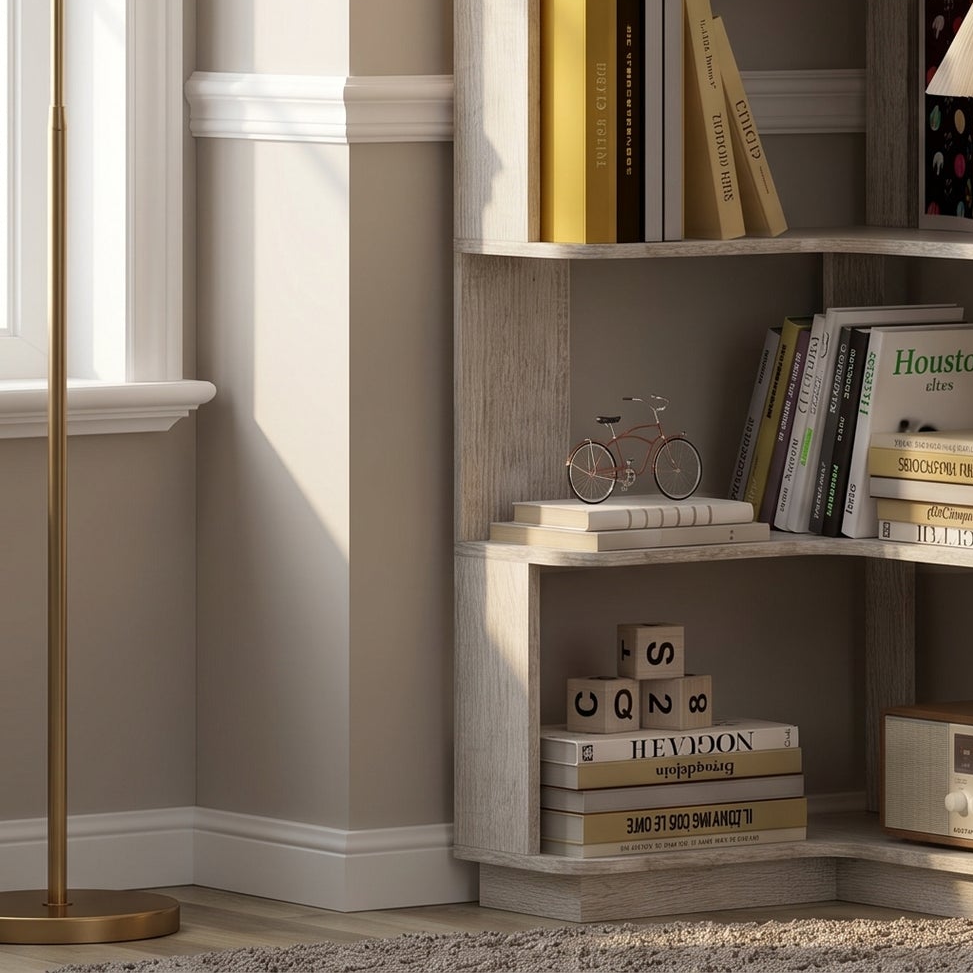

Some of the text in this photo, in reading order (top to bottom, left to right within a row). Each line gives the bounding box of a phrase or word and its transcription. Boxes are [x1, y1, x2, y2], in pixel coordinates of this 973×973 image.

[646, 641, 675, 666] S
[613, 688, 634, 720] Q
[648, 693, 673, 715] 2
[688, 692, 707, 714] 8
